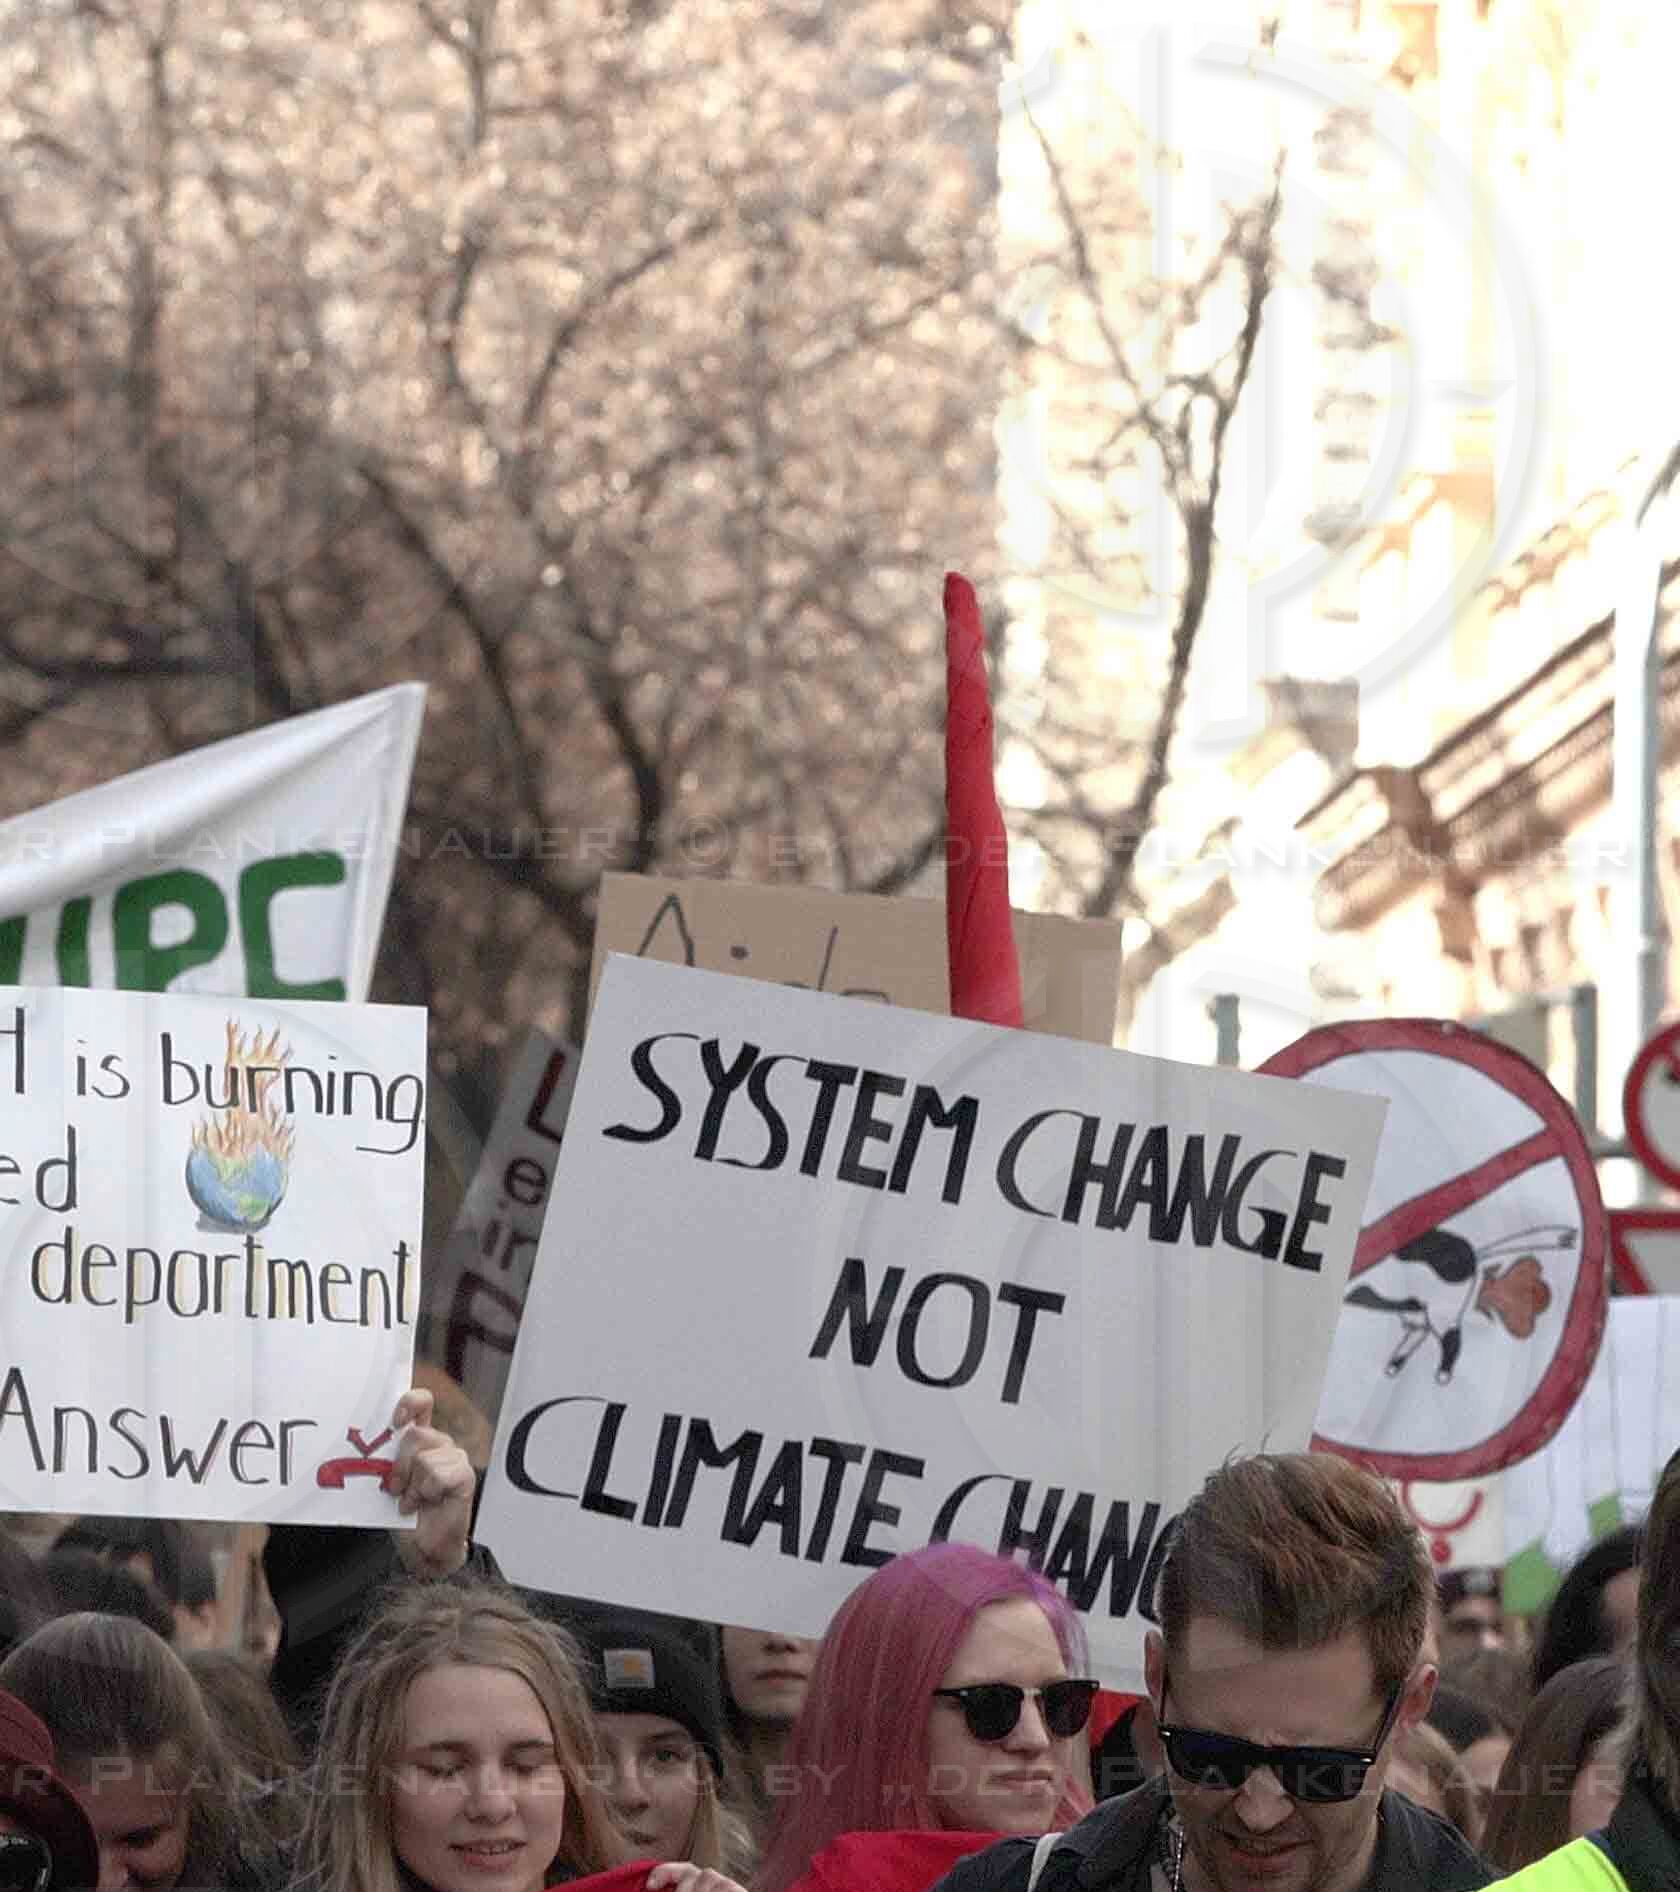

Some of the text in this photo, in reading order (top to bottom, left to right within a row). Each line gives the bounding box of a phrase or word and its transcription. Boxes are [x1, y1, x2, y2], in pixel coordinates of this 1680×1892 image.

[75, 1034, 132, 1100] is
[160, 1031, 425, 1155] burning
[602, 1032, 1348, 1273] SYSTEM CHANGE
[30, 1222, 413, 1330] department
[809, 1257, 1066, 1406] NOT
[504, 1394, 925, 1569] CLIMATE
